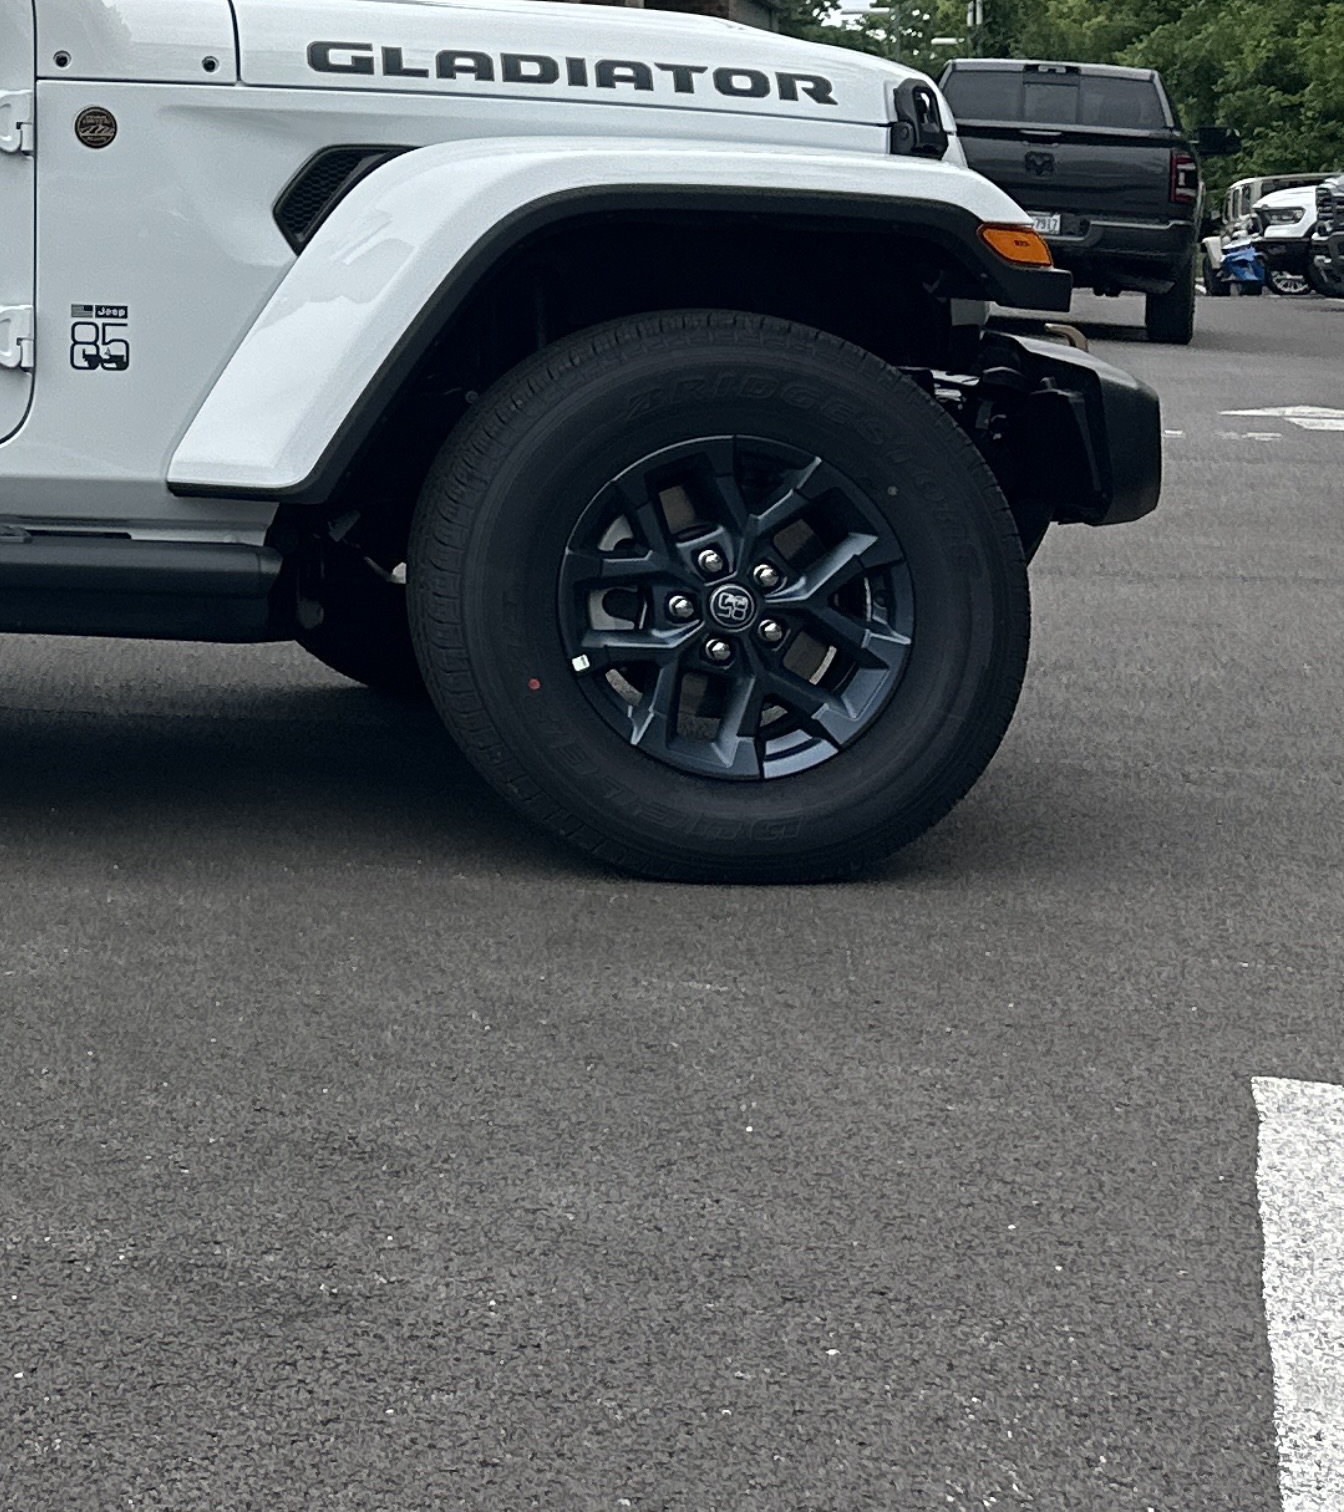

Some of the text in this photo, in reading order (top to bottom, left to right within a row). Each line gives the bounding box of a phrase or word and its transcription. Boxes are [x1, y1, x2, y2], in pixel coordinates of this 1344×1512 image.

[306, 40, 838, 105] GLADIATOR
[97, 306, 126, 318] Jeep
[70, 321, 129, 371] 85
